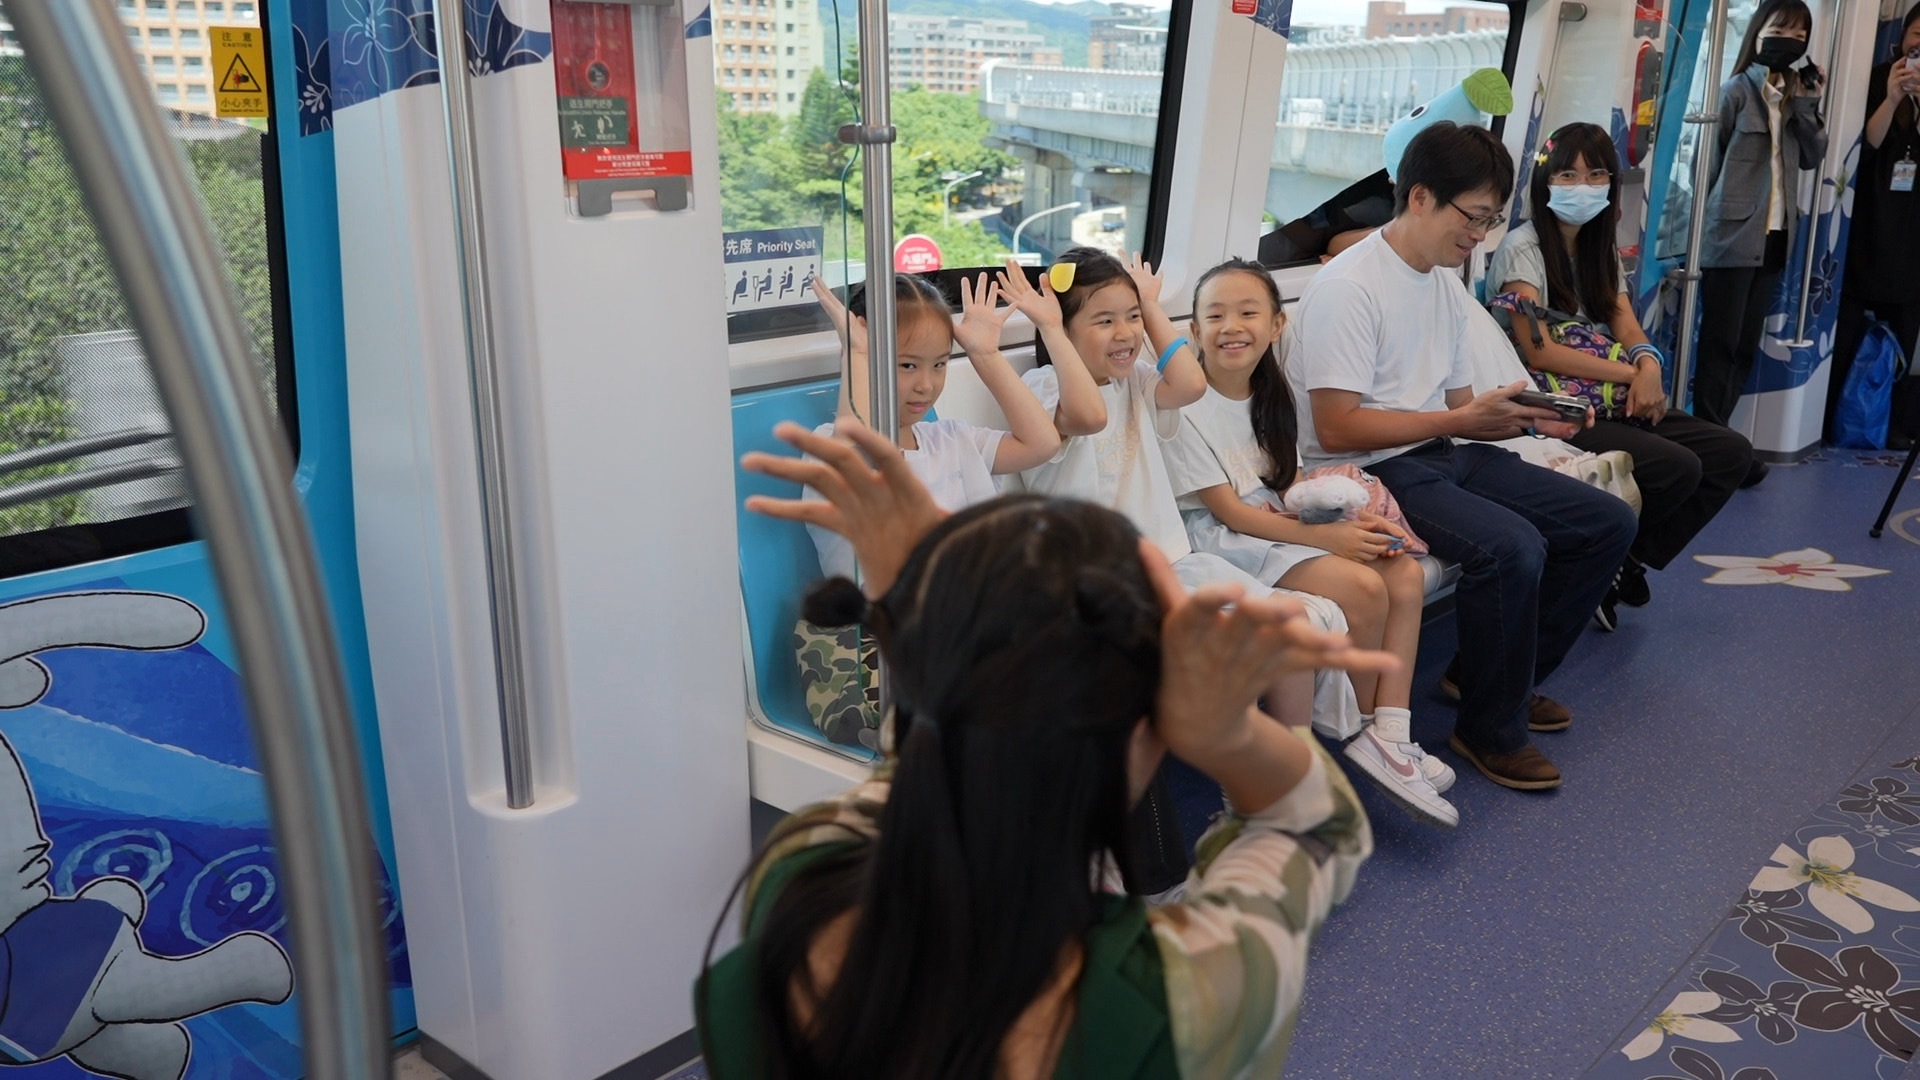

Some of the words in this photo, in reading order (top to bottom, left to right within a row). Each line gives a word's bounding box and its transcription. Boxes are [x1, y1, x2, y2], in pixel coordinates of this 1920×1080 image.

[222, 31, 252, 42] 注意
[723, 238, 753, 256] 先席
[757, 241, 793, 254] Priority
[795, 239, 816, 250] Seat
